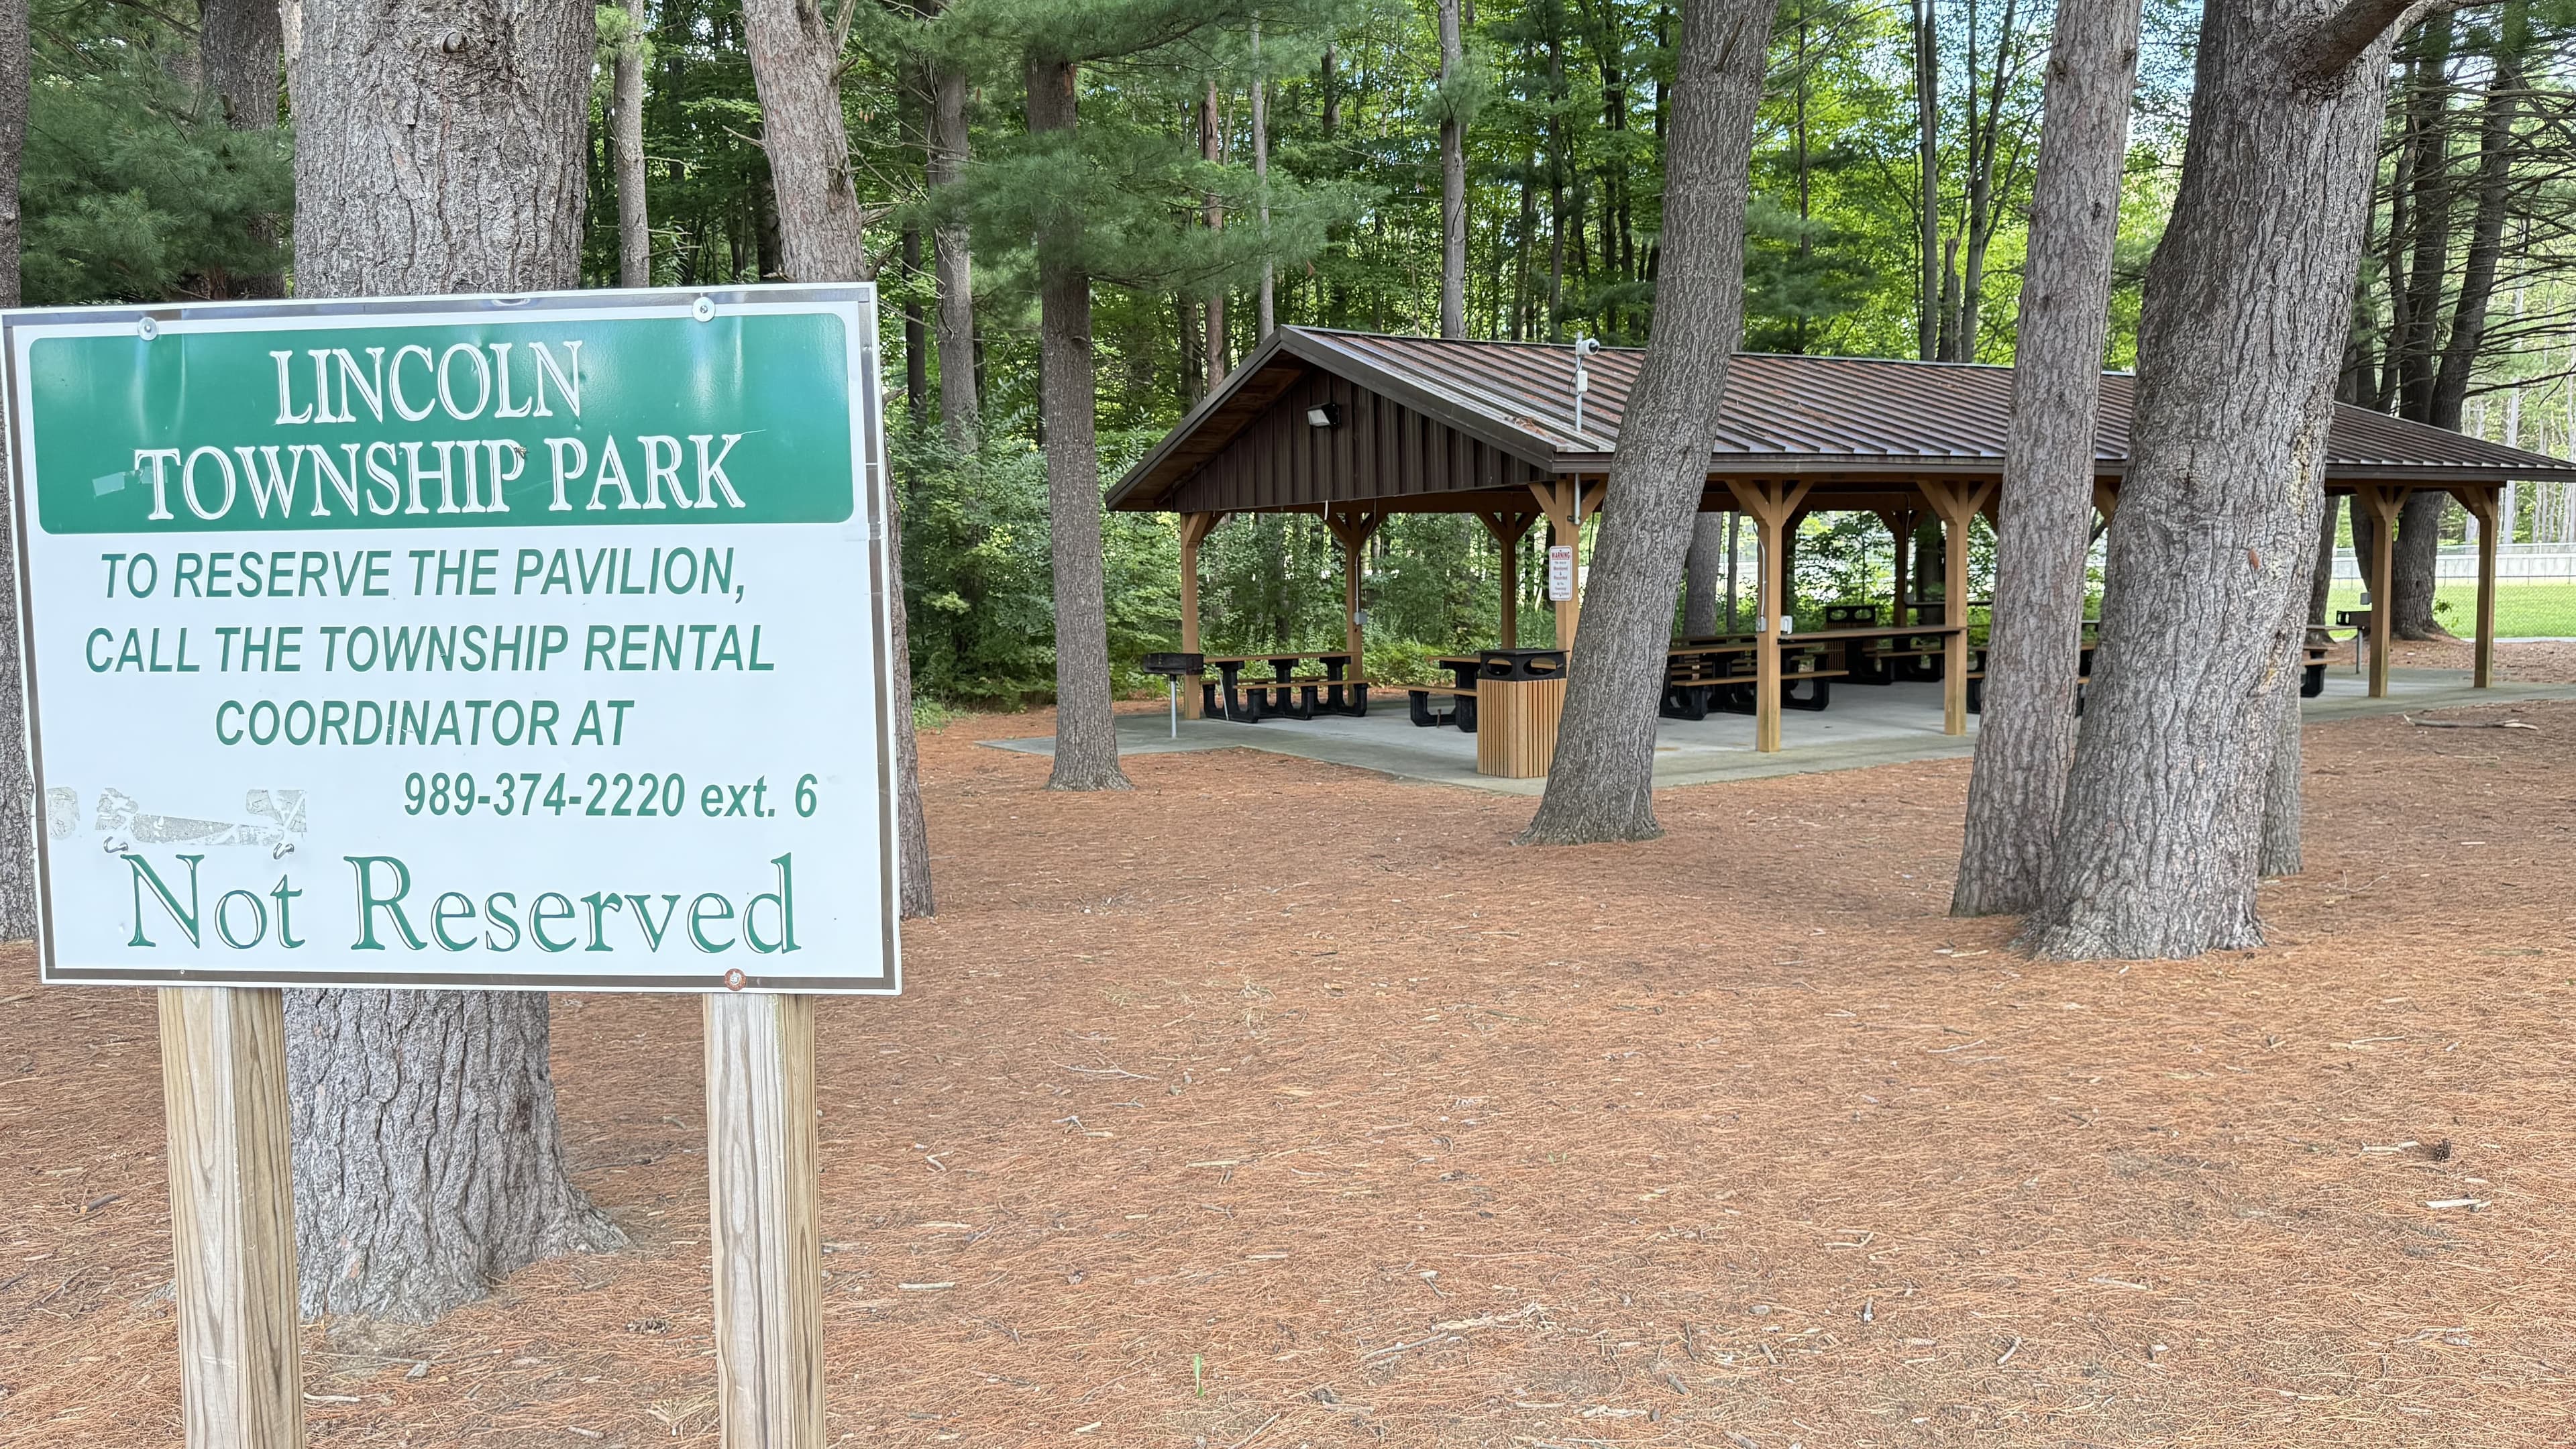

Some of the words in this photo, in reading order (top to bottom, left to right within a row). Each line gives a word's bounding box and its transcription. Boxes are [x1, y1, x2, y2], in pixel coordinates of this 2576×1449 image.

[269, 339, 584, 426] LINCOLN
[135, 439, 525, 521] TOWNSHIP
[543, 433, 747, 512] PARK
[101, 553, 158, 598] TO
[174, 551, 391, 598] RESERVE
[409, 549, 499, 596] THE
[514, 547, 746, 604] PAVILION,
[86, 628, 200, 673] CALL
[215, 627, 303, 672] THE
[321, 626, 569, 672] TOWNSHIP
[584, 625, 775, 672] RENTAL
[215, 700, 559, 746] COORDINATOR
[572, 700, 635, 746] AT
[405, 772, 686, 817] 989-374-2220
[700, 778, 776, 818] ext.
[795, 773, 817, 818] 6
[119, 853, 306, 949] Not
[343, 852, 801, 955] Reserved
